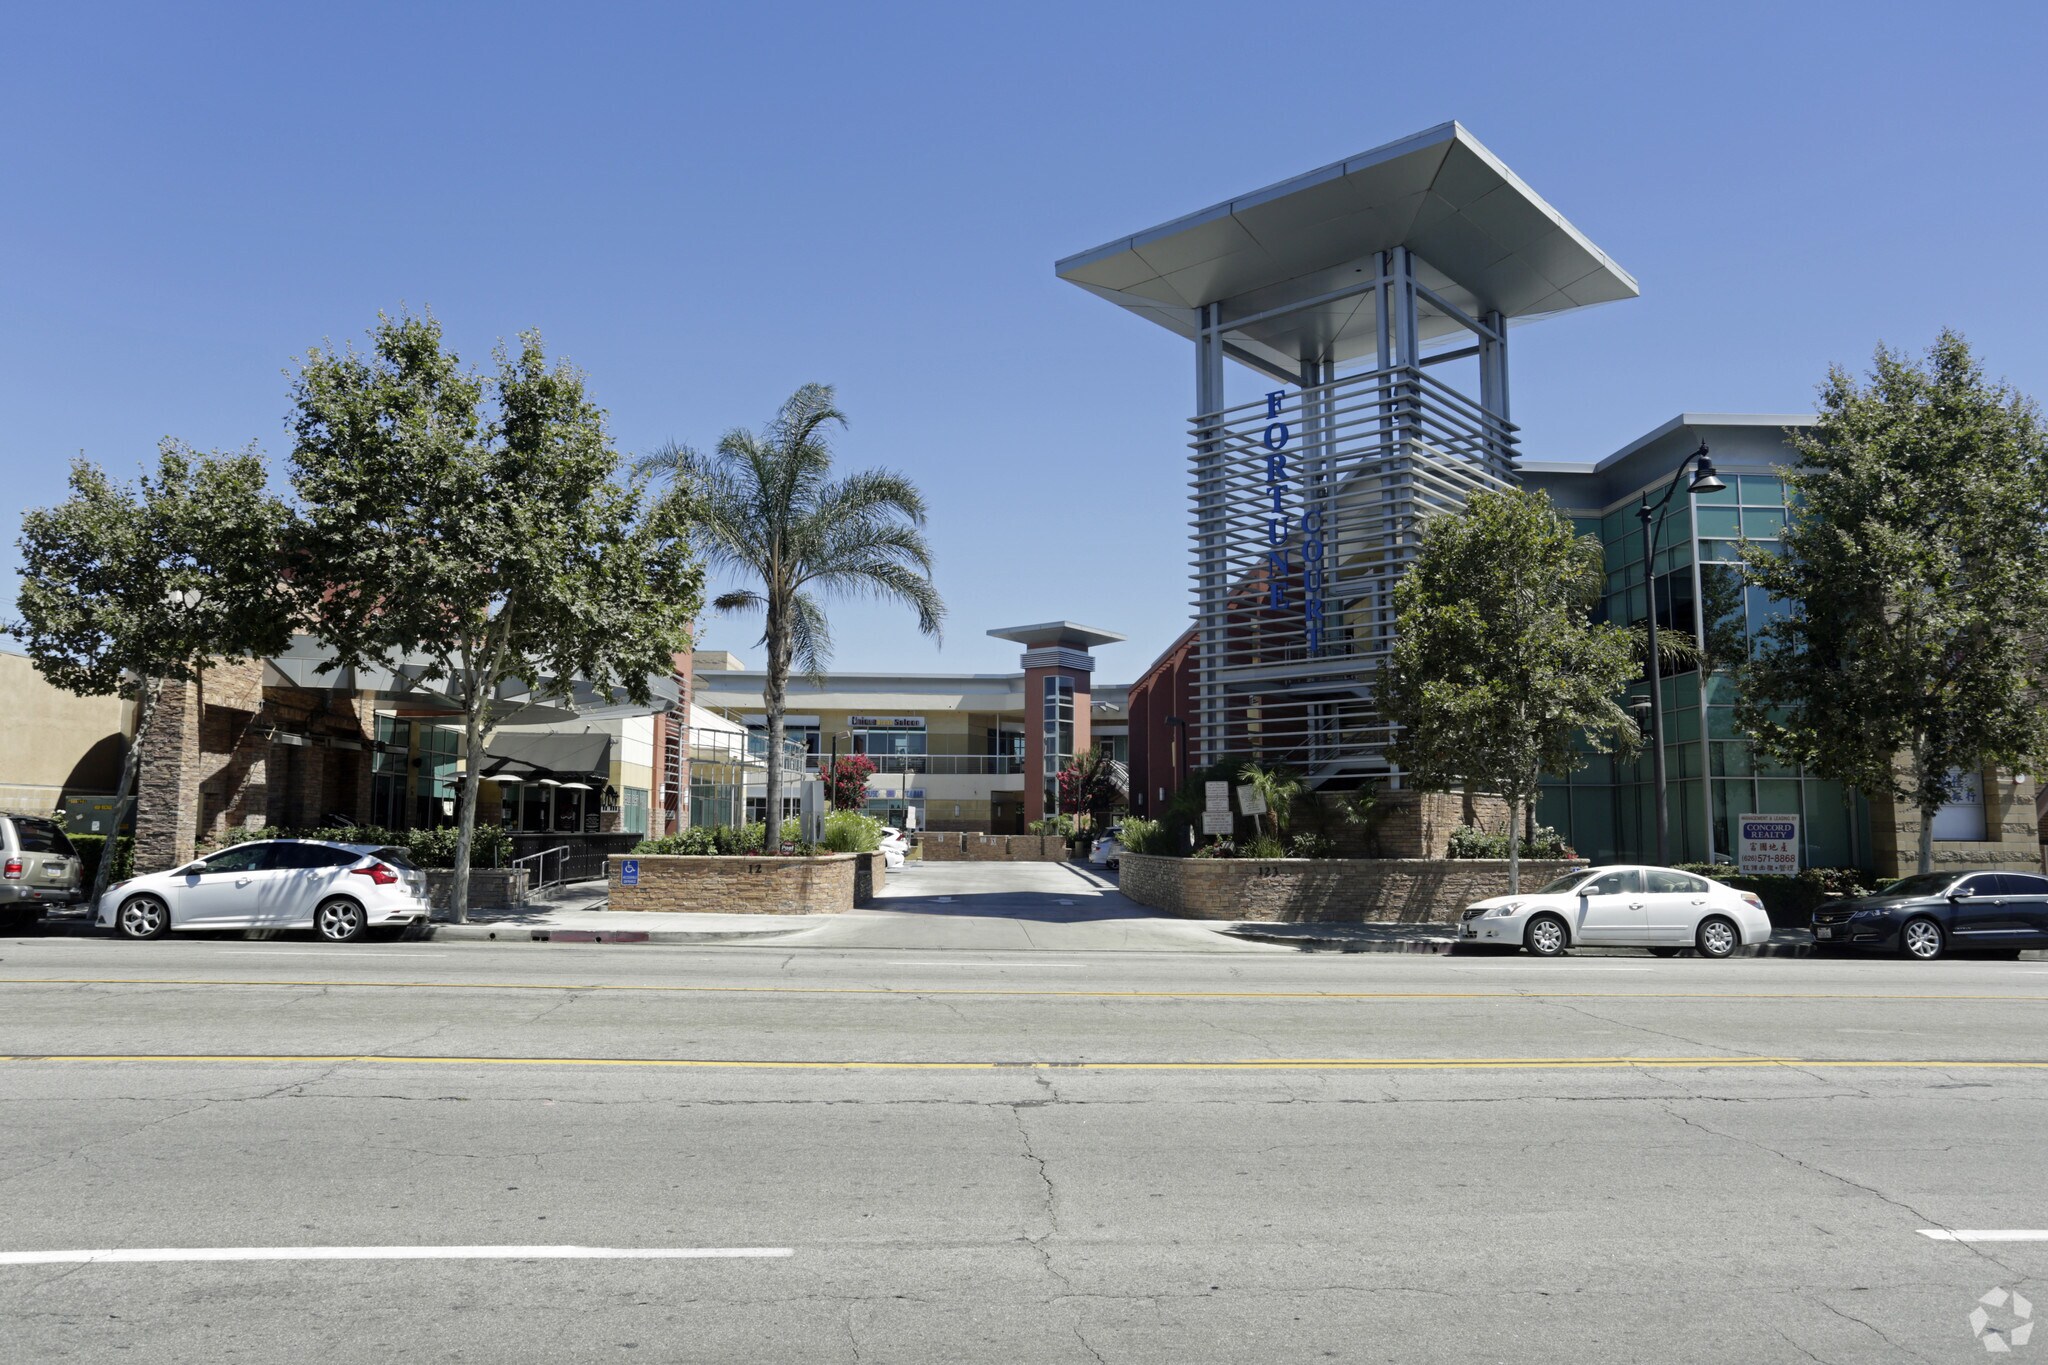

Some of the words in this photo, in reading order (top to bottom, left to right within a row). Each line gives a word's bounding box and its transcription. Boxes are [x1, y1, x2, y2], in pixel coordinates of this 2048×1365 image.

[1264, 389, 1290, 610] FORTUNE
[1301, 510, 1324, 652] COURT
[747, 864, 762, 874] 12
[1258, 866, 1279, 877] 123
